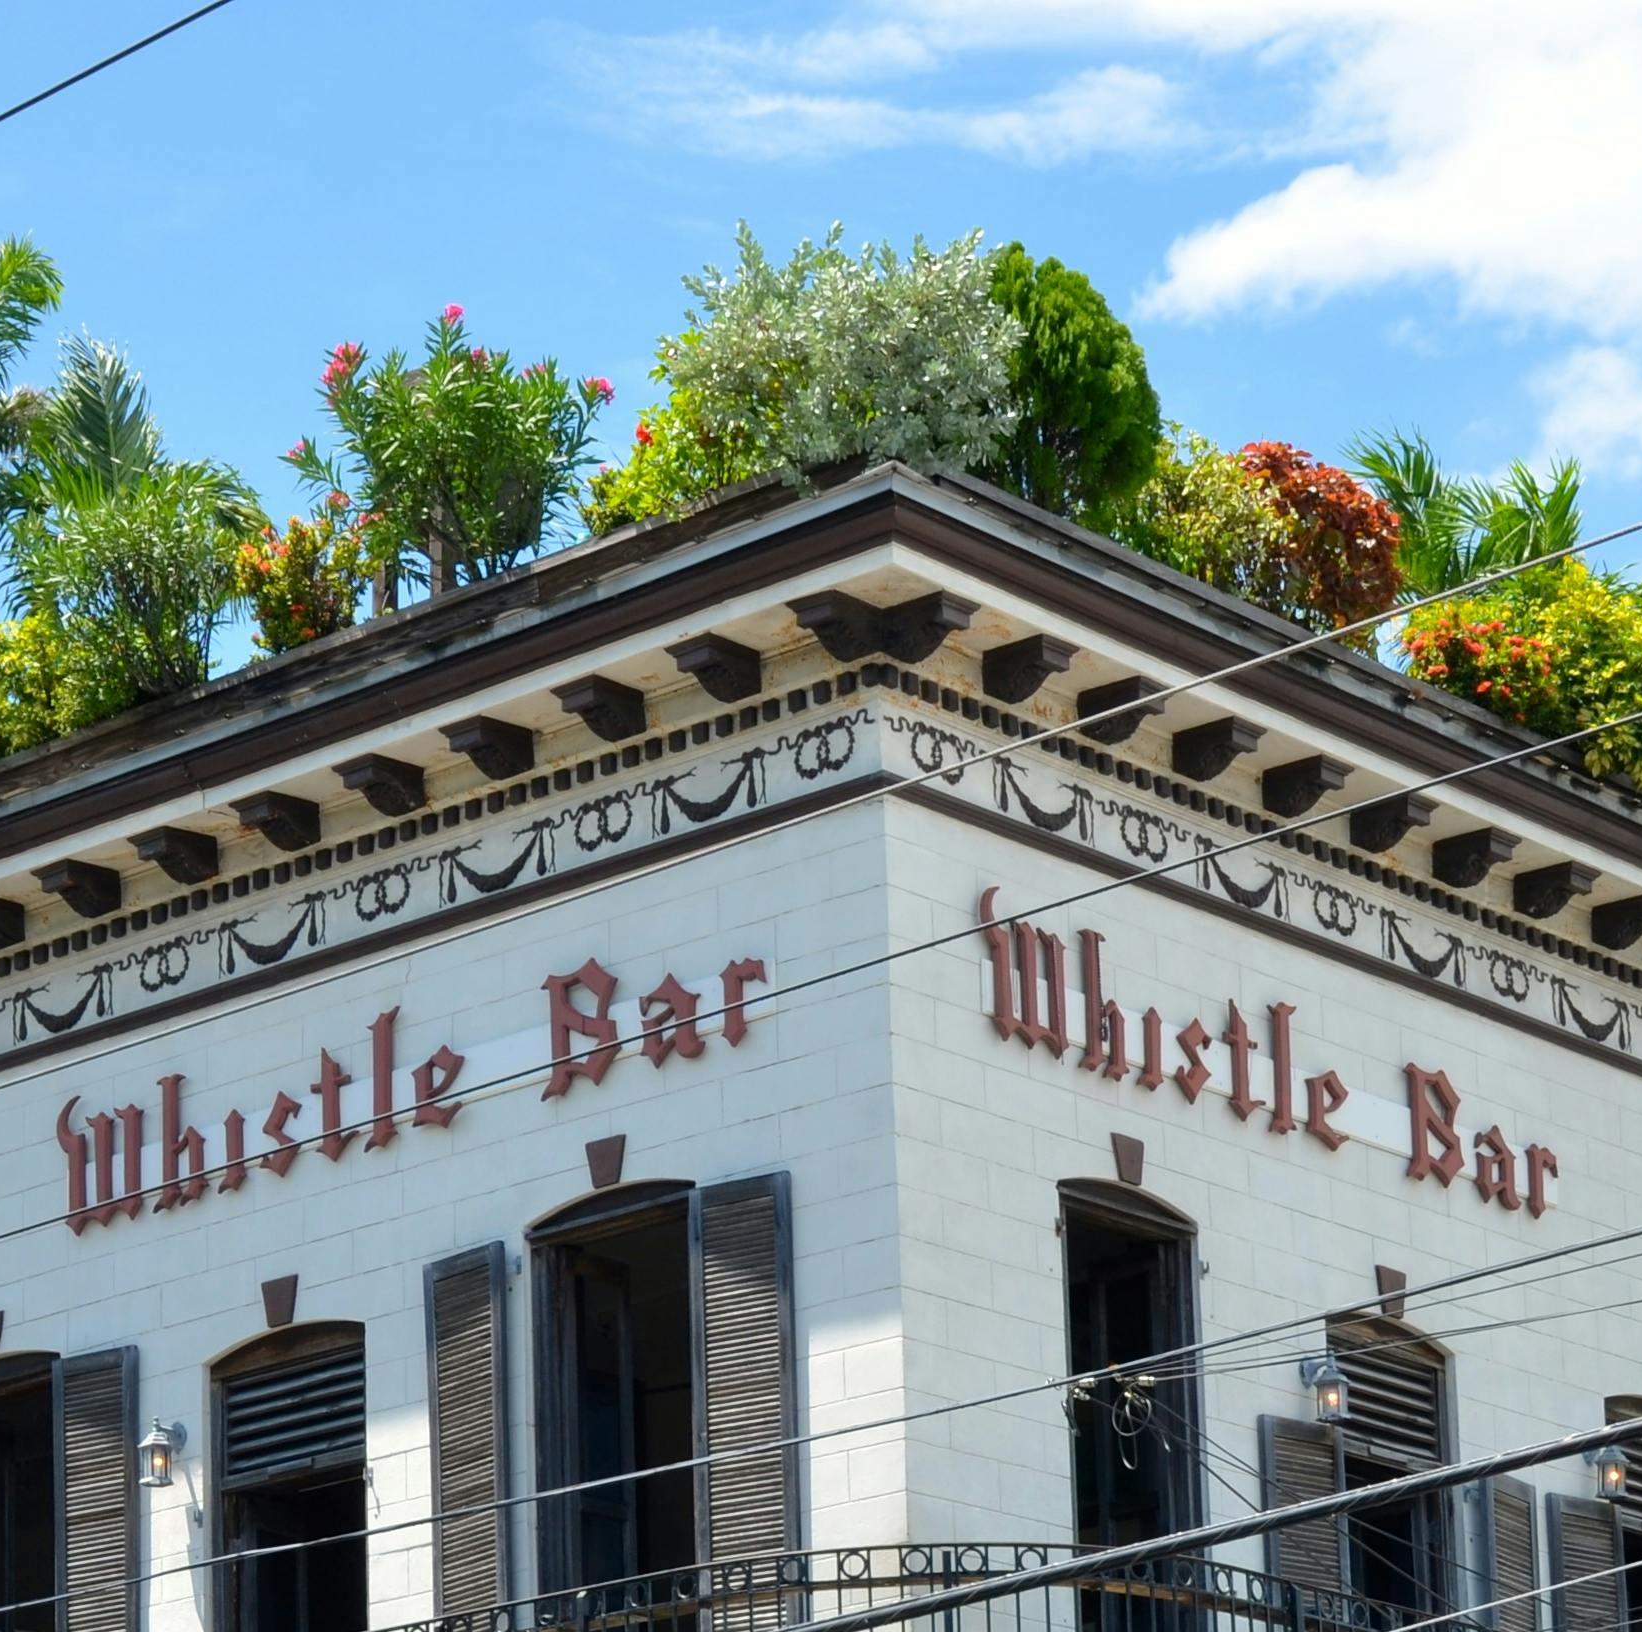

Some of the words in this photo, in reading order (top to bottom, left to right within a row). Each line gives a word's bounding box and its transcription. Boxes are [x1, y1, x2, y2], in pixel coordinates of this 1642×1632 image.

[57, 1006, 465, 1237] Whistle
[541, 957, 767, 1102] Bar
[979, 886, 1350, 1152] Whistle
[1403, 1062, 1559, 1219] Bar
